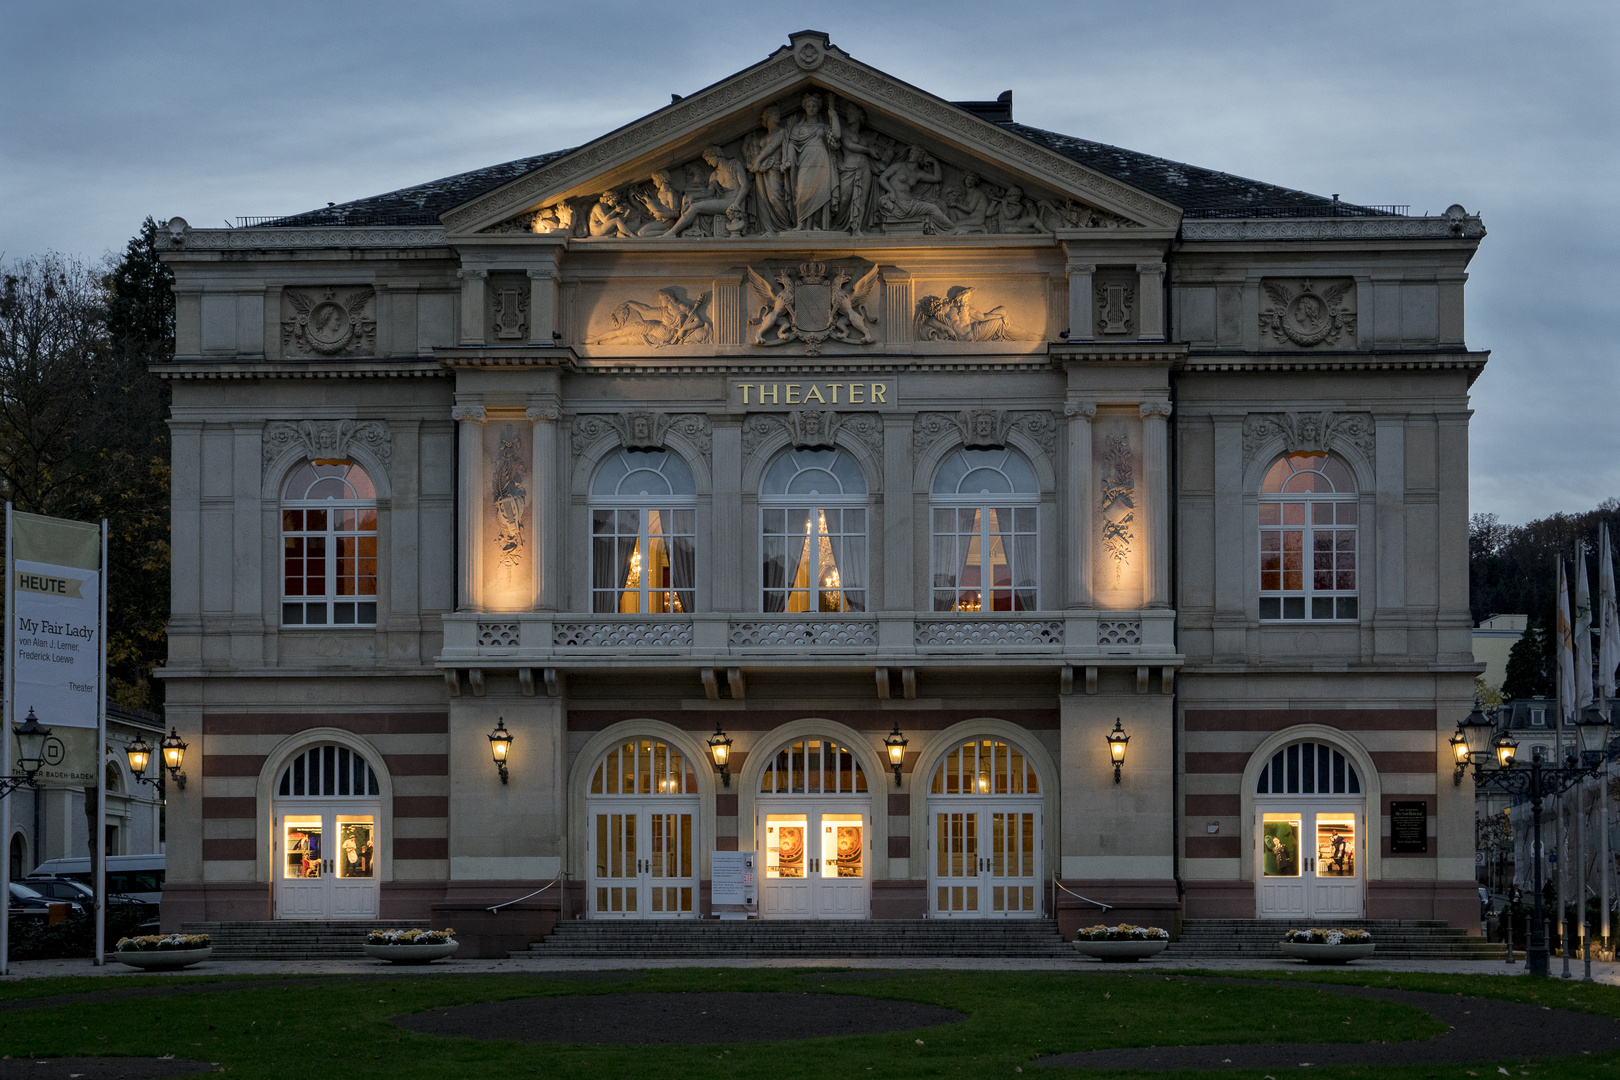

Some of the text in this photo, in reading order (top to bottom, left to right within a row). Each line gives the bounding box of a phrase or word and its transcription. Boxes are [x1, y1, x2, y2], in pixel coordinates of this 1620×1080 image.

[737, 383, 887, 404] THEATER
[20, 575, 66, 593] HEUTE
[19, 617, 94, 641] My Fair Lady
[19, 638, 80, 652] von Alan J. Lerner,
[19, 649, 74, 664] Frederick Loewe
[69, 682, 94, 693] Theater
[12, 768, 94, 779] THEER BADEN-BADEN
